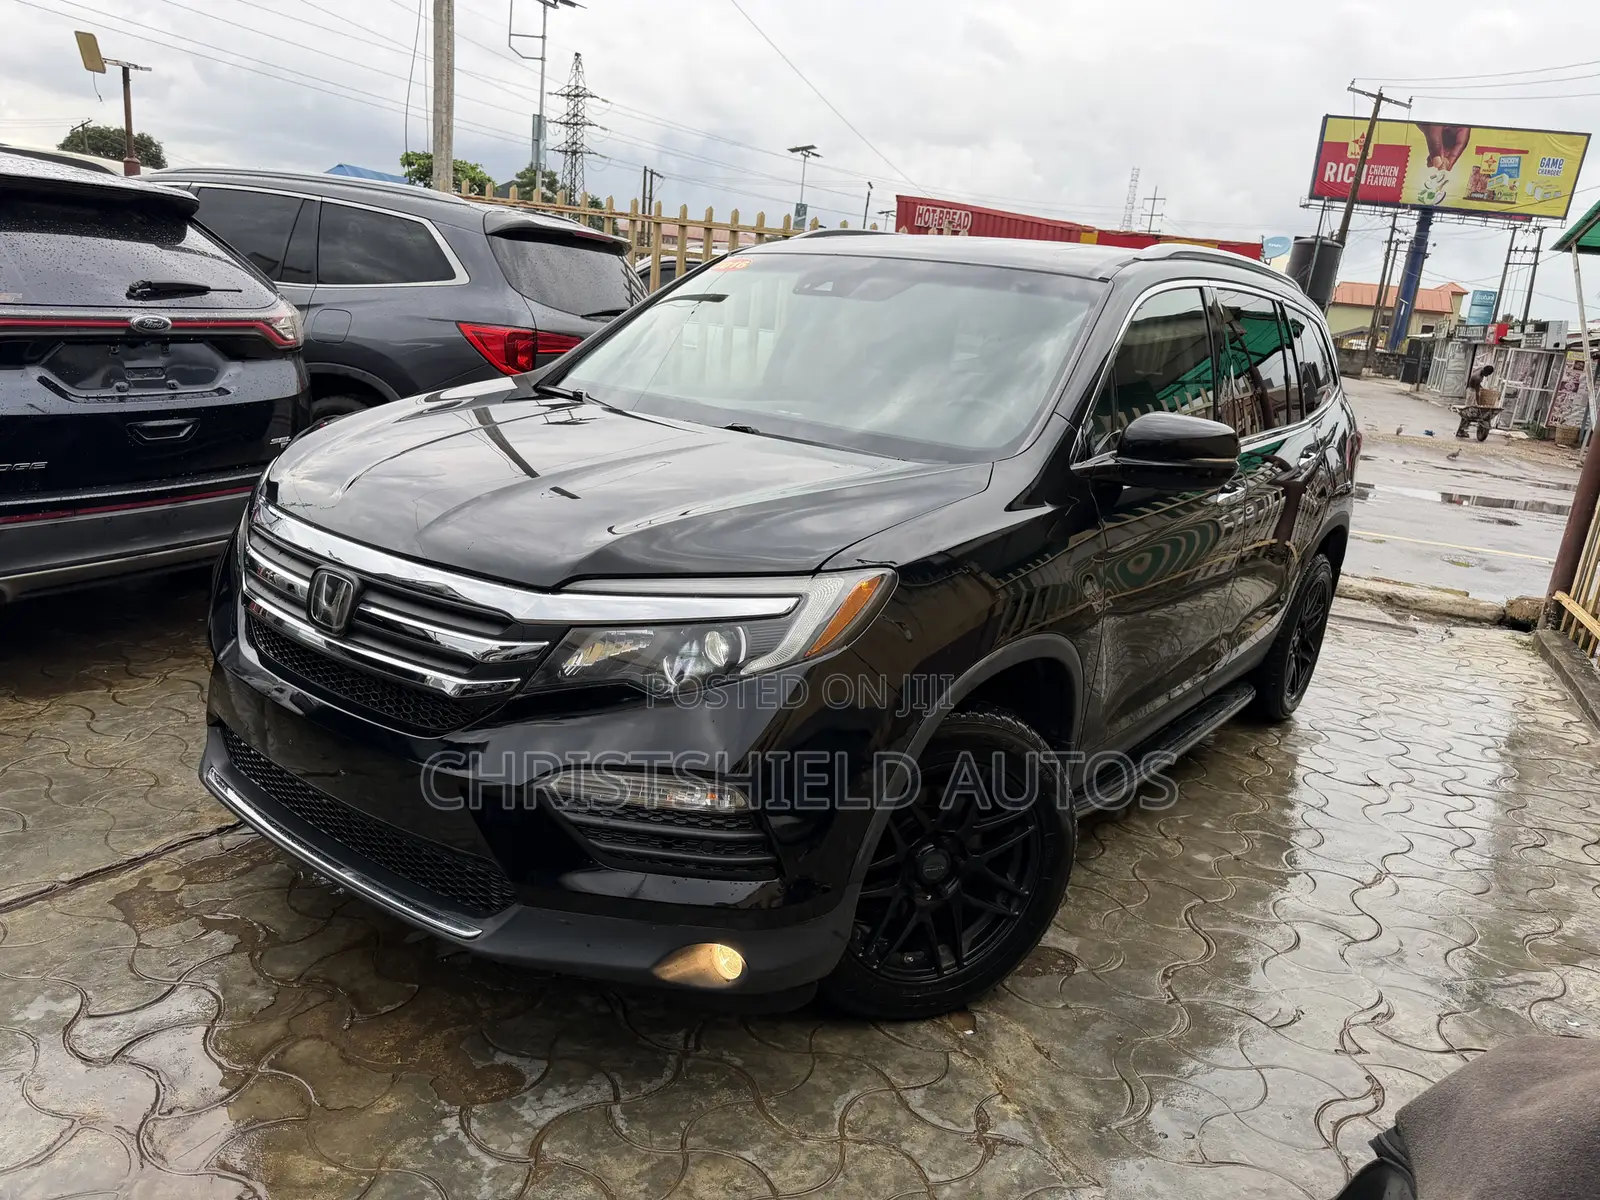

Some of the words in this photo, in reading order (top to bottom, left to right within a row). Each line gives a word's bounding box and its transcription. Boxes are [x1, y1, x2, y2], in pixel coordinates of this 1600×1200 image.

[1369, 164, 1399, 177] CHICKEN
[1366, 175, 1397, 188] FLAVOUR
[143, 318, 165, 329] Ford
